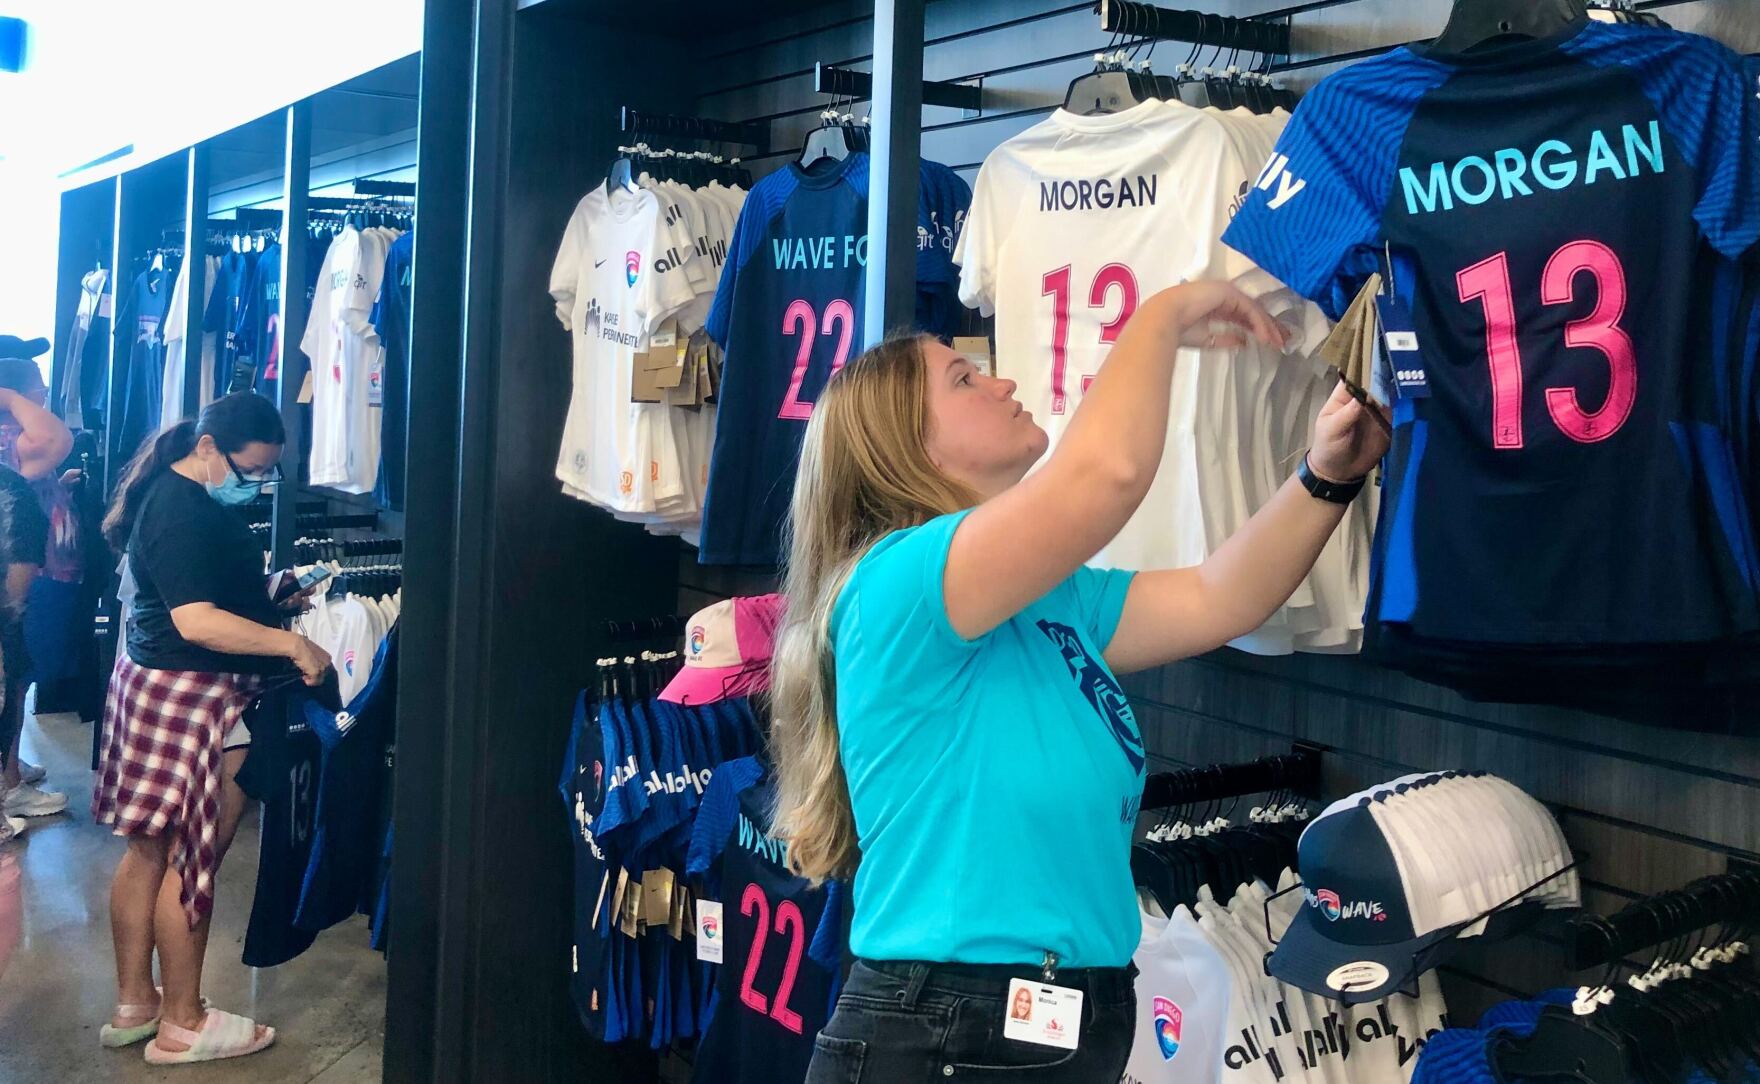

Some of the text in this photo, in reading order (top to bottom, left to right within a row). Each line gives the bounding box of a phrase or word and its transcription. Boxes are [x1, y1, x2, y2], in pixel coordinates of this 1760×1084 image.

[1039, 173, 1158, 212] MORGAN
[1400, 120, 1664, 214] MORGAN
[772, 236, 836, 270] WAVE
[777, 299, 855, 421] 22
[1456, 240, 1637, 448] 13
[1342, 900, 1384, 920] WAVE
[740, 882, 805, 1035] 22
[1163, 1002, 1180, 1023] DIEGO
